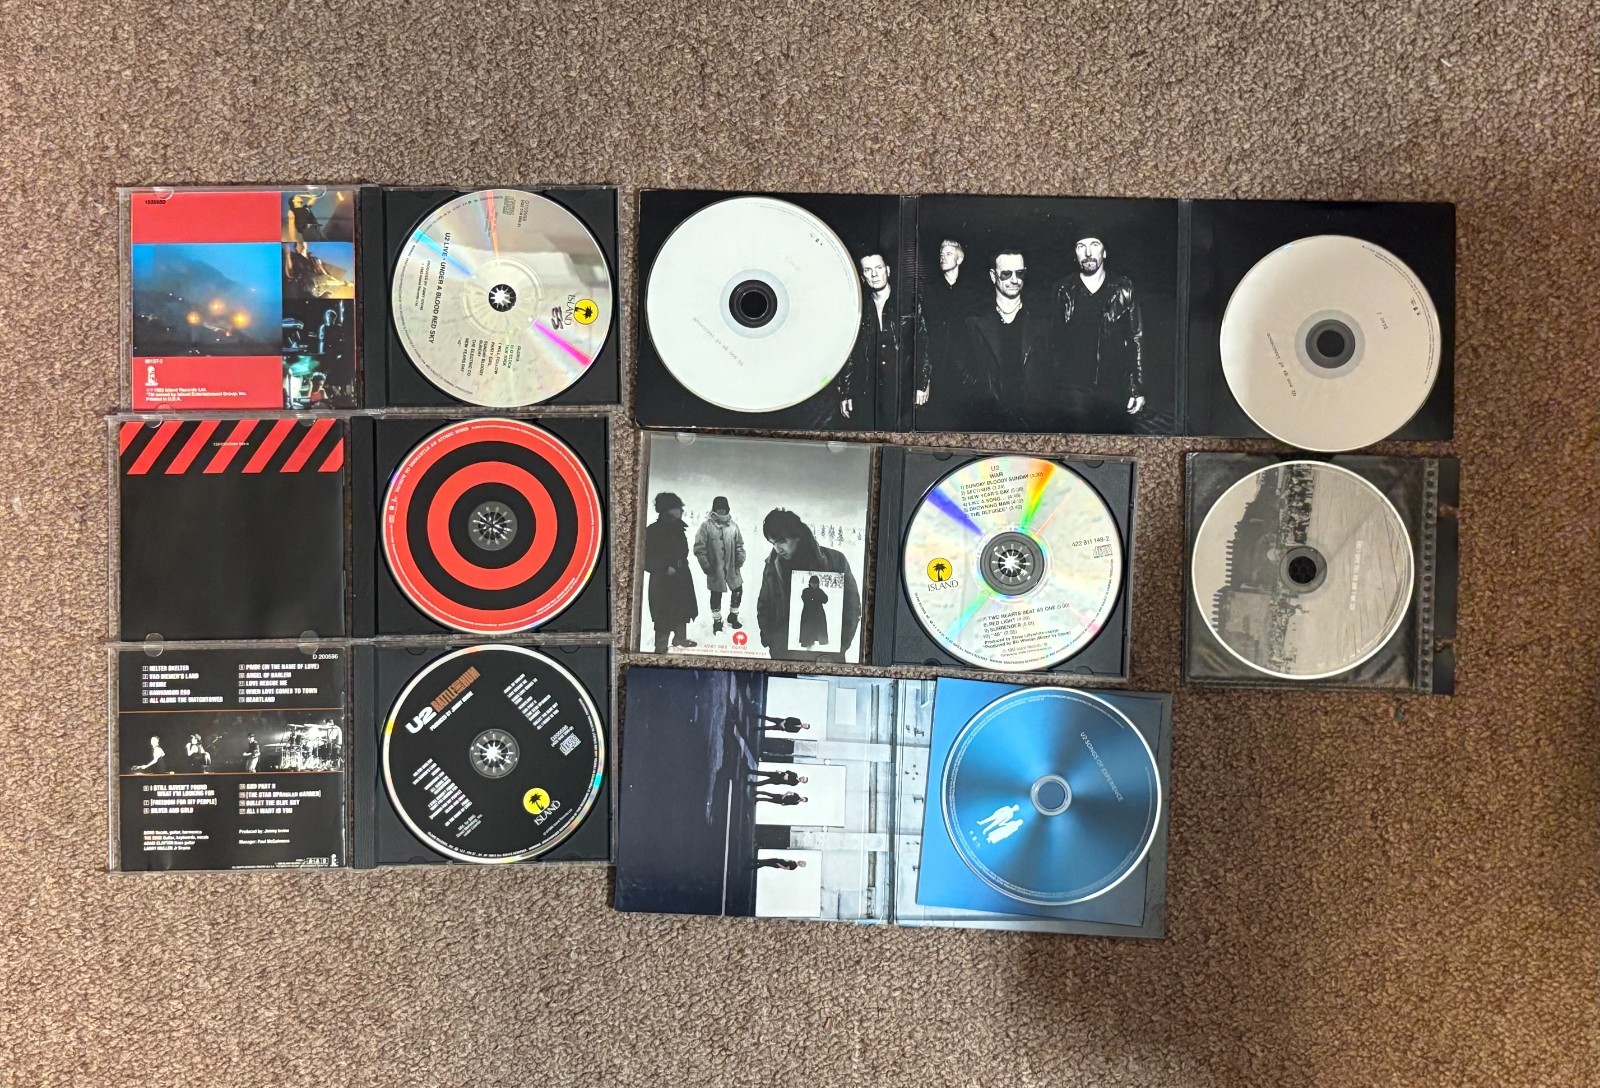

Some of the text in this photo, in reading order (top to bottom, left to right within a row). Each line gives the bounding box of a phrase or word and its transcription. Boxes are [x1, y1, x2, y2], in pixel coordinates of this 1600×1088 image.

[444, 232, 451, 241] U2
[437, 262, 446, 284] UNDER
[433, 292, 442, 314] BLOOD
[564, 294, 575, 325] ISLAND
[927, 579, 959, 592] ISLAND
[405, 706, 438, 734] U2
[429, 685, 459, 713] RATTLE
[458, 666, 481, 688] HUM
[1080, 731, 1124, 802] U2 SONGS OF EXPERIENCE
[534, 800, 561, 825] ISLAND
